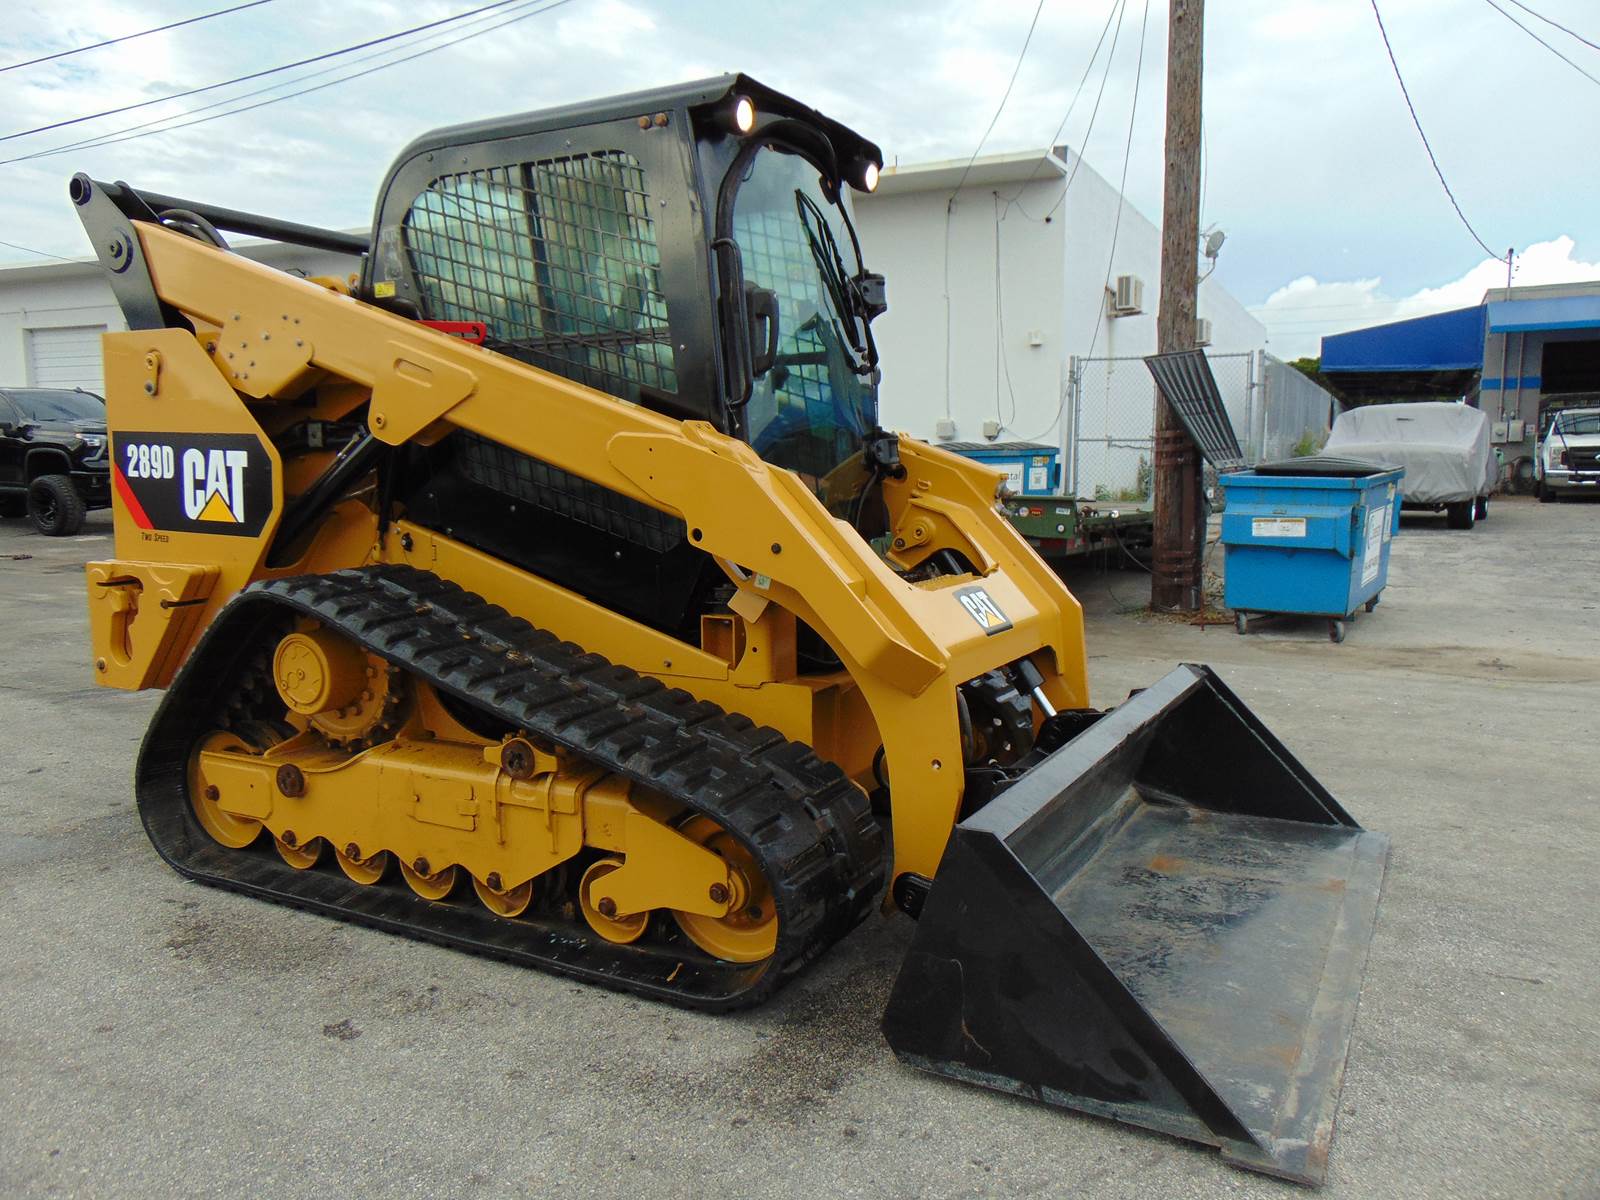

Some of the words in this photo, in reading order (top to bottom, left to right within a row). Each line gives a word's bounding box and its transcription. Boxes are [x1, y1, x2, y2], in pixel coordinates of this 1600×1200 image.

[127, 444, 175, 479] 289D
[183, 448, 248, 523] CAT
[960, 591, 1007, 628] CAT
